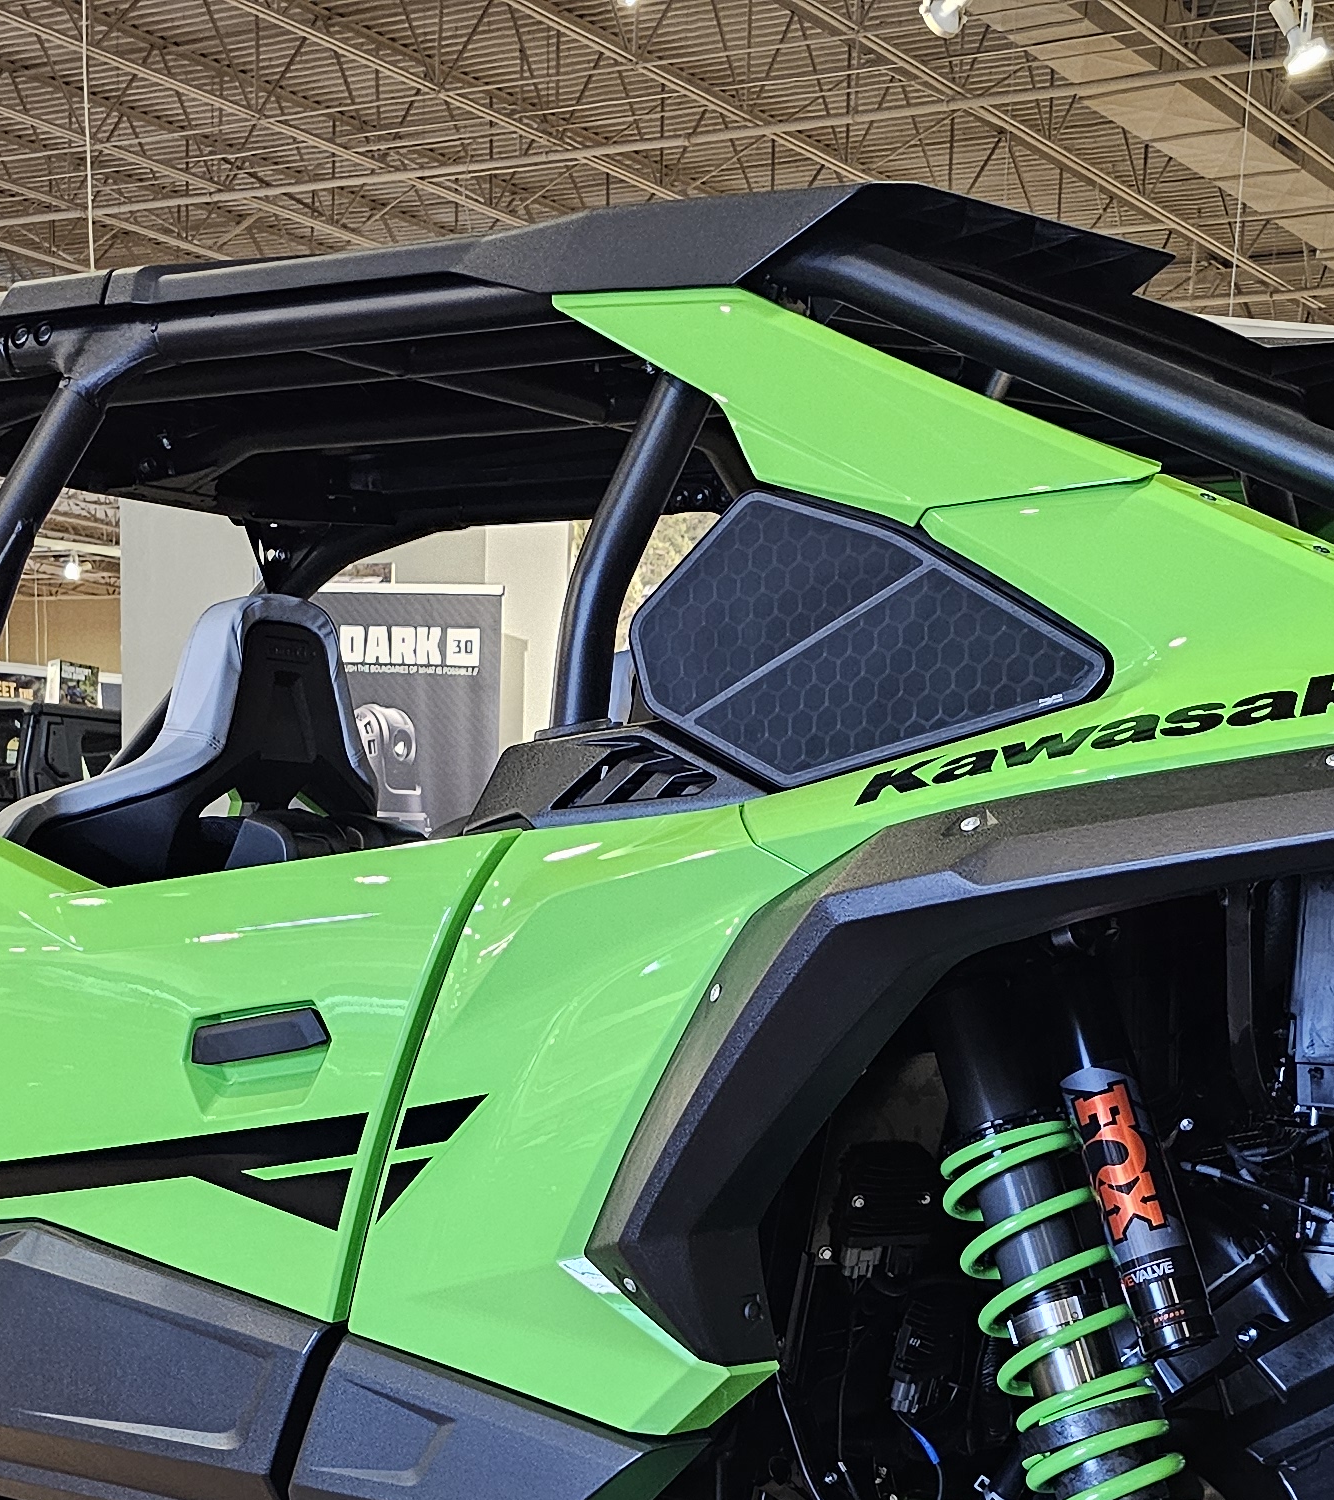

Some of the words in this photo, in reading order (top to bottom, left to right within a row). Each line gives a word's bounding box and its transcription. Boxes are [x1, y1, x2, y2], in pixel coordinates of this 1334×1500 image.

[339, 624, 442, 665] DARK
[452, 639, 474, 654] 30
[1073, 1081, 1168, 1243] FOX
